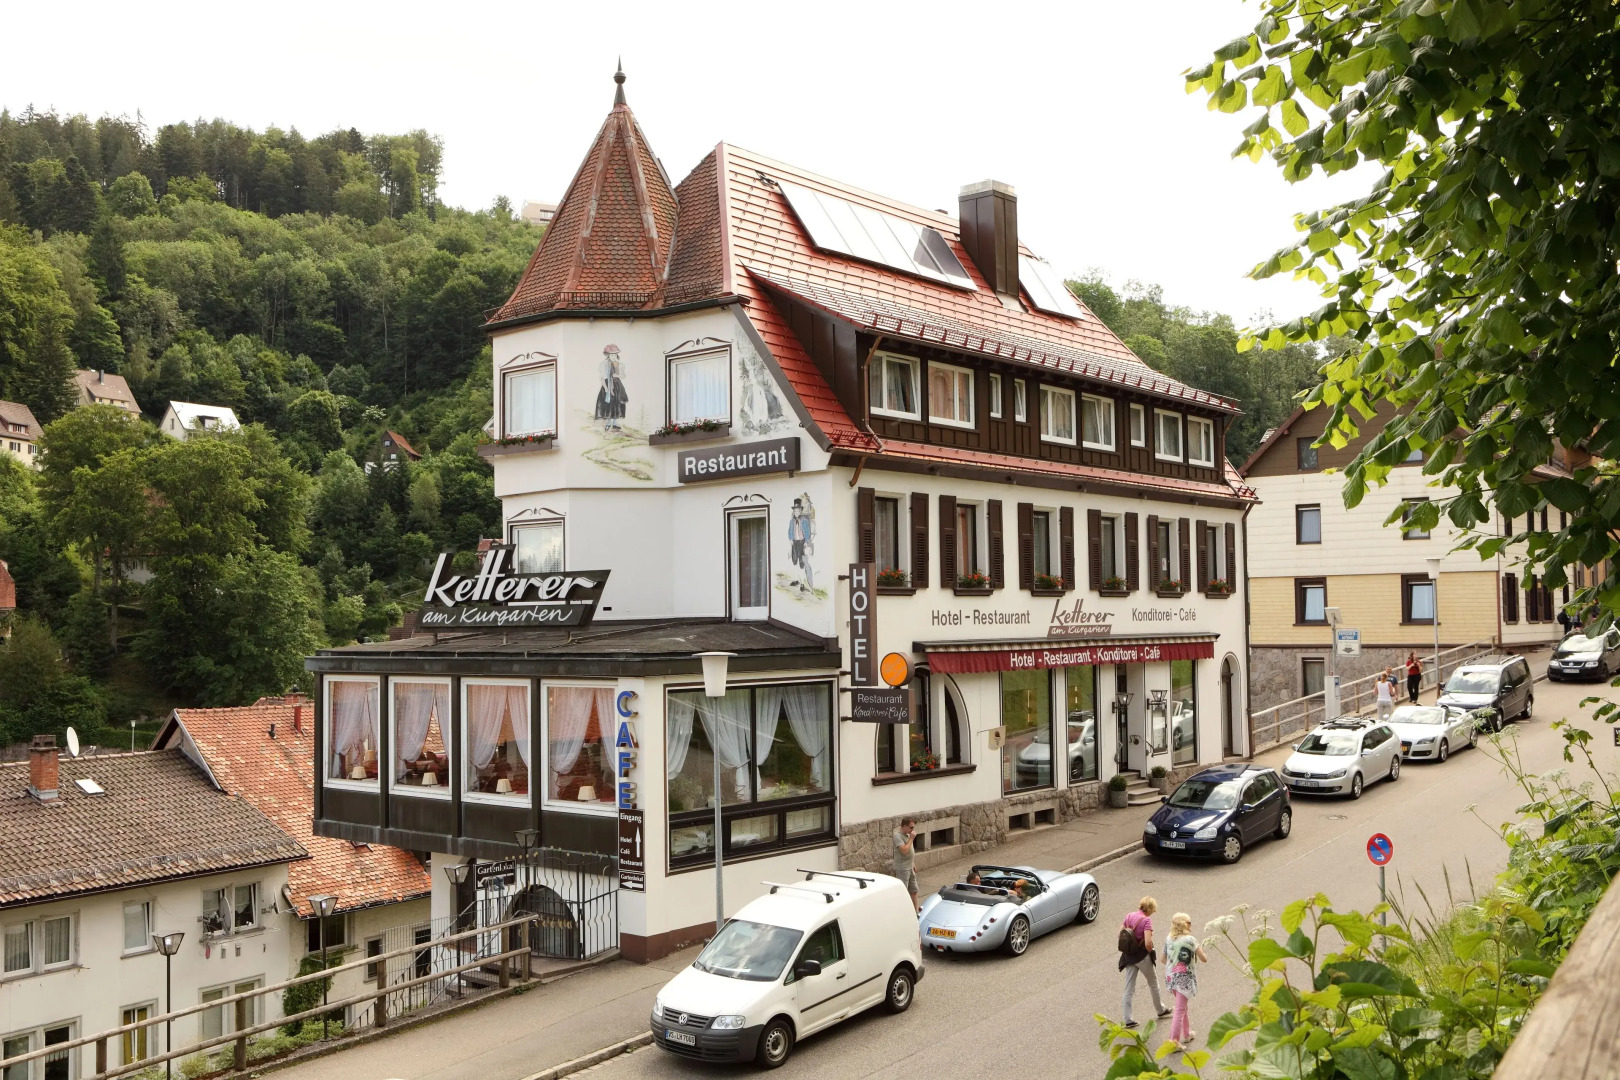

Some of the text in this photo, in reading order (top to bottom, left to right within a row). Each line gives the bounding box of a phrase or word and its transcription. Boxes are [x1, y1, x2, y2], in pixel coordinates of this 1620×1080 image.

[684, 445, 787, 476] Restaurant
[422, 605, 573, 626] am Kurgarten
[931, 609, 962, 626] Hotel
[973, 609, 1031, 625] Restaurant
[1131, 608, 1172, 622] Konditorei
[1178, 608, 1196, 621] Café
[851, 568, 868, 682] HOTEL
[1050, 627, 1066, 635] am
[1010, 652, 1035, 667] Hotel
[1043, 650, 1092, 666] Restaurant
[1097, 647, 1138, 662] Konditorei
[1144, 646, 1161, 659] Café
[857, 693, 903, 704] Restaurant
[616, 690, 635, 810] CAFE
[620, 812, 642, 824] Eingang
[620, 858, 643, 867] Restaurant
[620, 874, 643, 882] Gartenlokal
